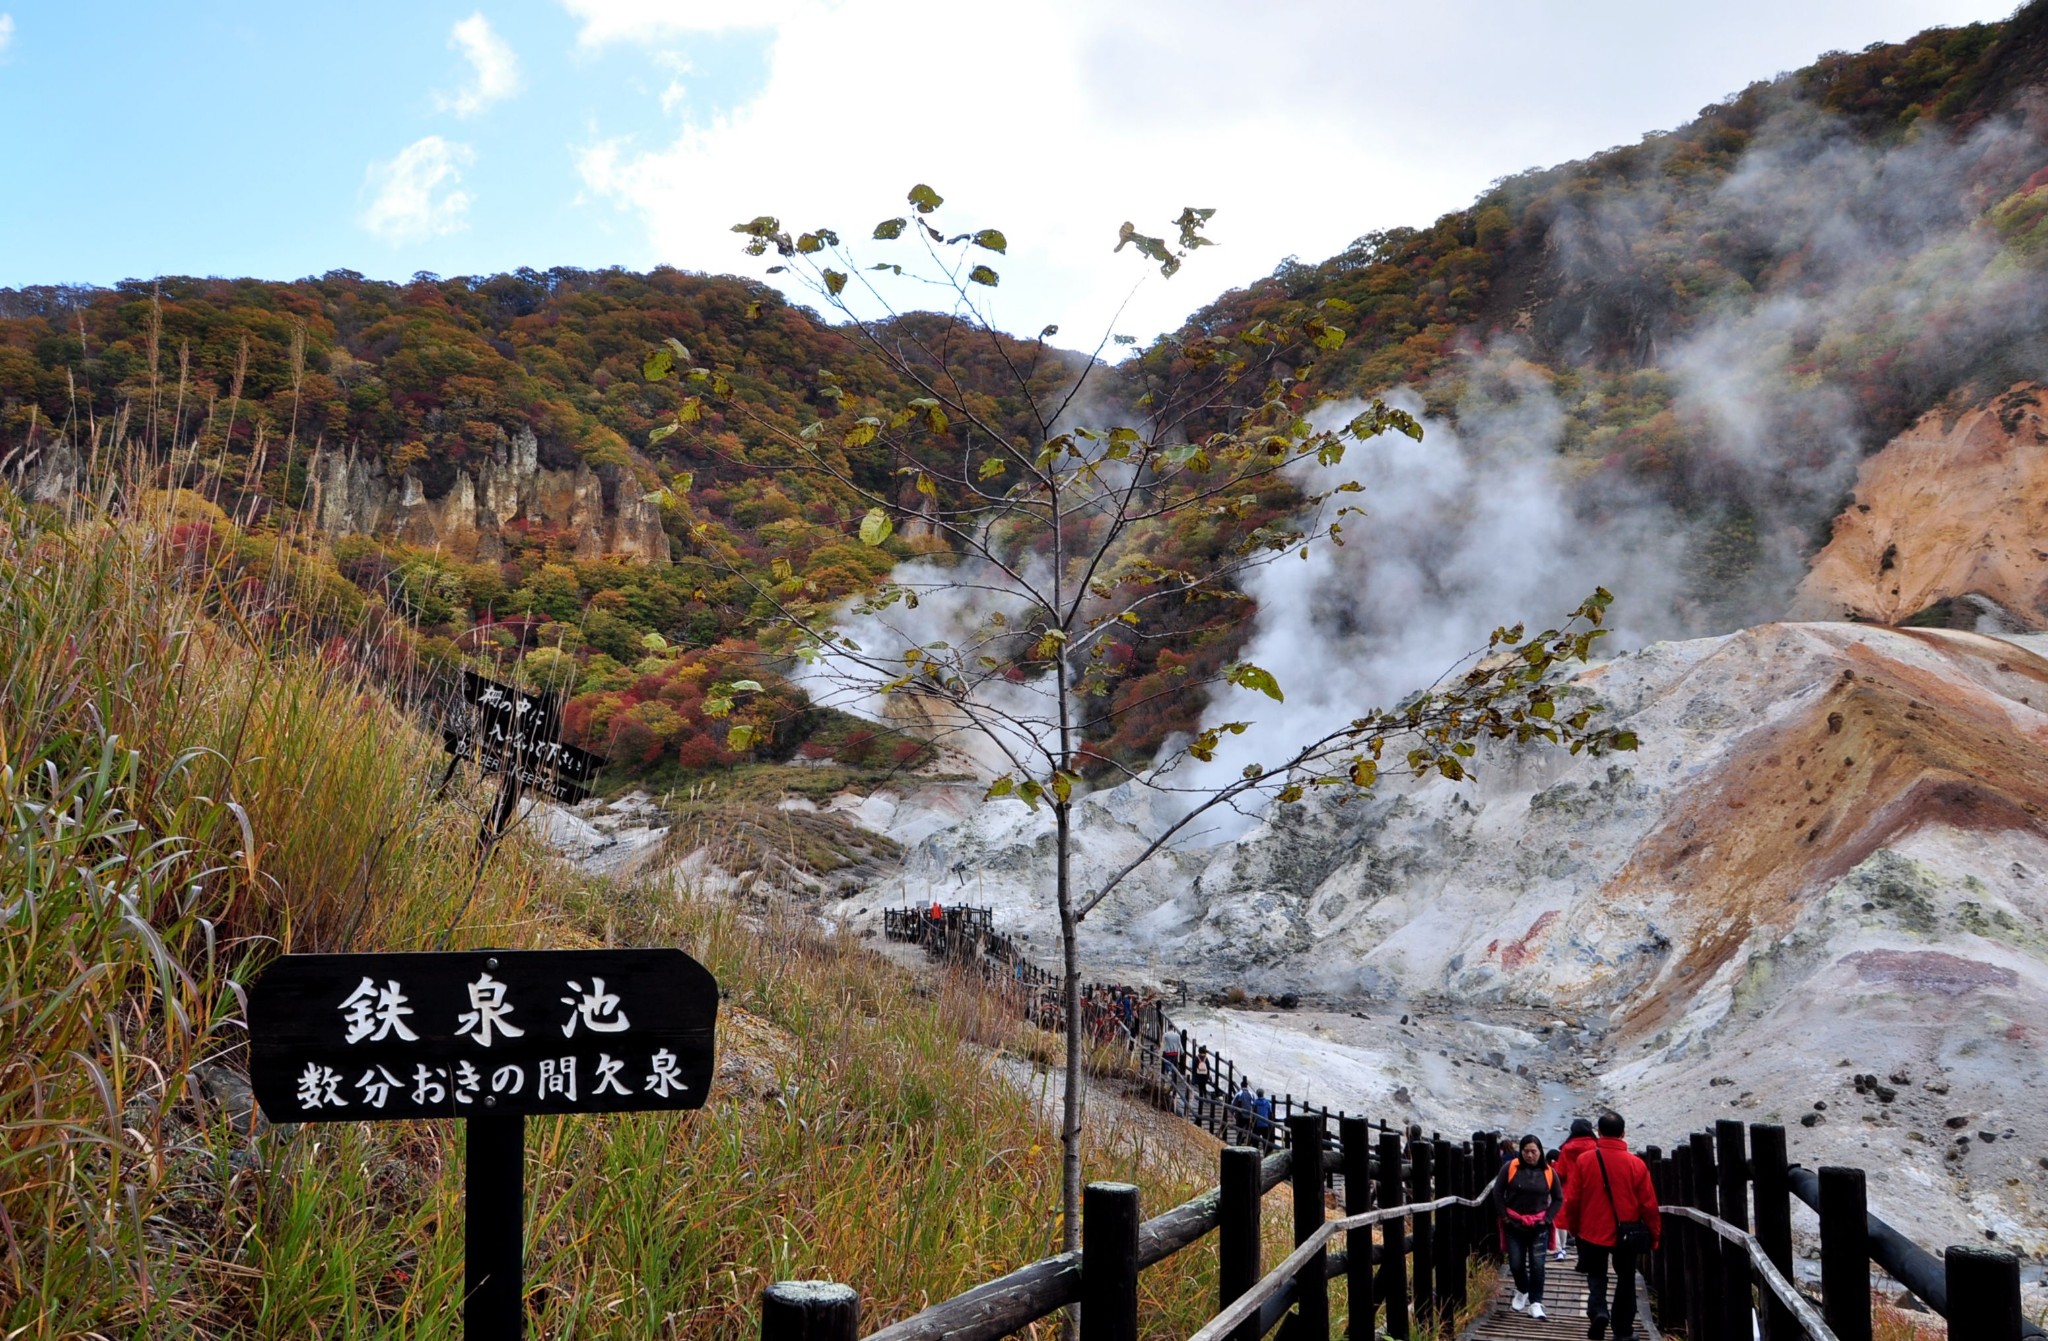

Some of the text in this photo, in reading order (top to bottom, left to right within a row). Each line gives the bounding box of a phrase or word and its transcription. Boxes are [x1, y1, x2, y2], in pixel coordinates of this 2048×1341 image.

[542, 777, 568, 798] OUT
[337, 972, 632, 1048] 鉄泉池
[296, 1047, 689, 1110] 数分おきの間欠泉
